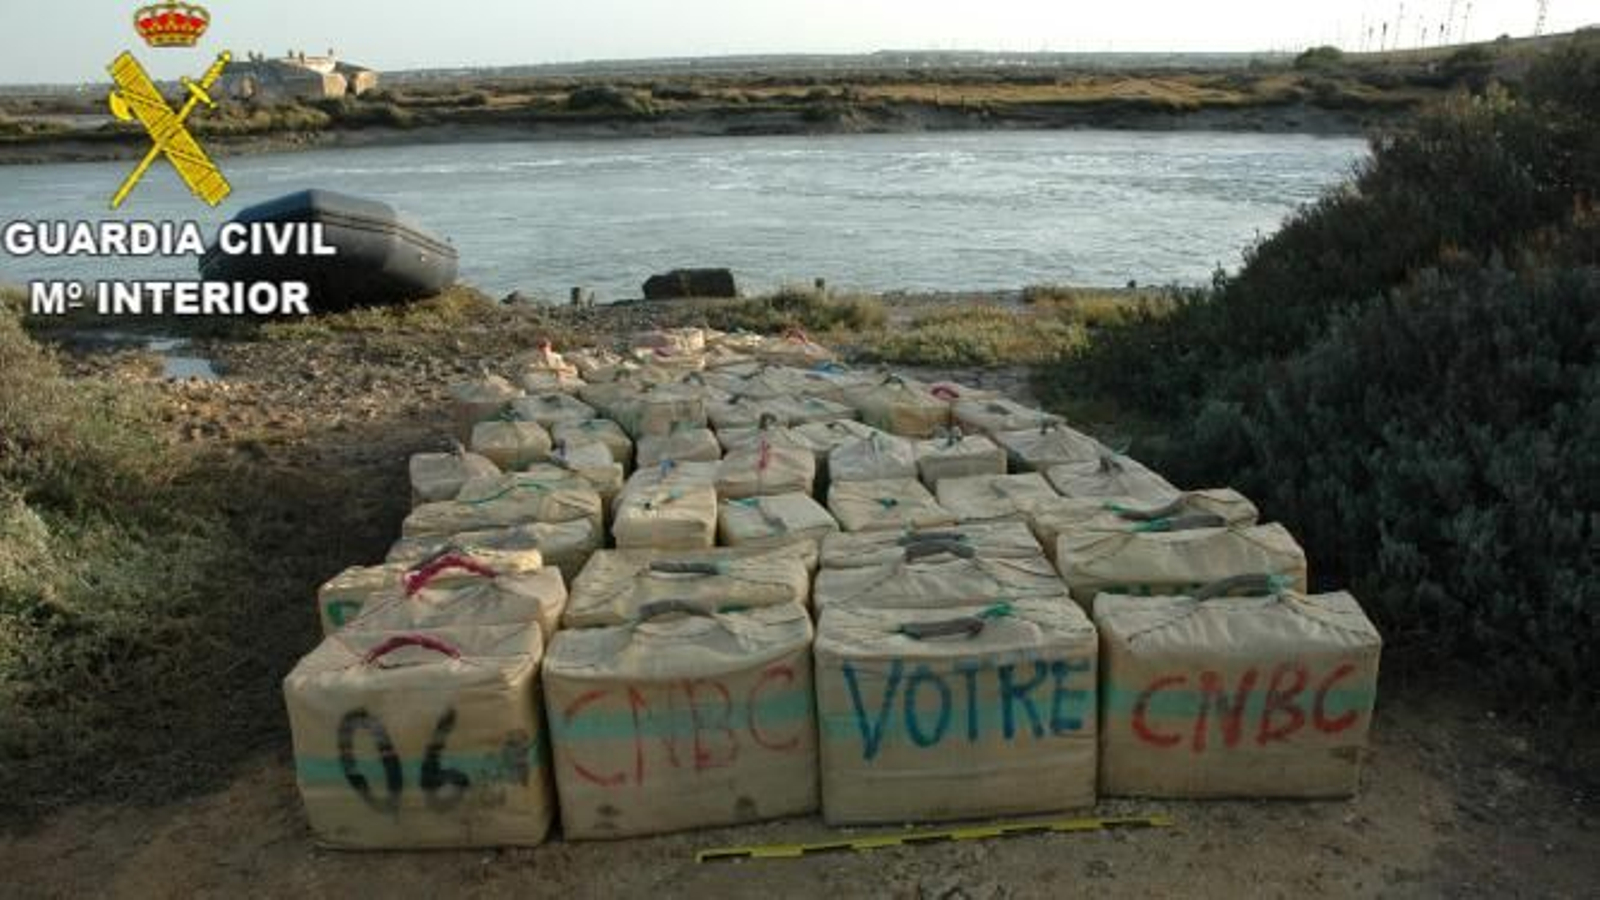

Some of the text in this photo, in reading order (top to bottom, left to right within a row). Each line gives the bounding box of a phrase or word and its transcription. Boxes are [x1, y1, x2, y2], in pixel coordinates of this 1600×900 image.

[562, 664, 806, 788] CNBC
[842, 656, 1092, 760] VOTRE
[1131, 661, 1360, 752] CNBC
